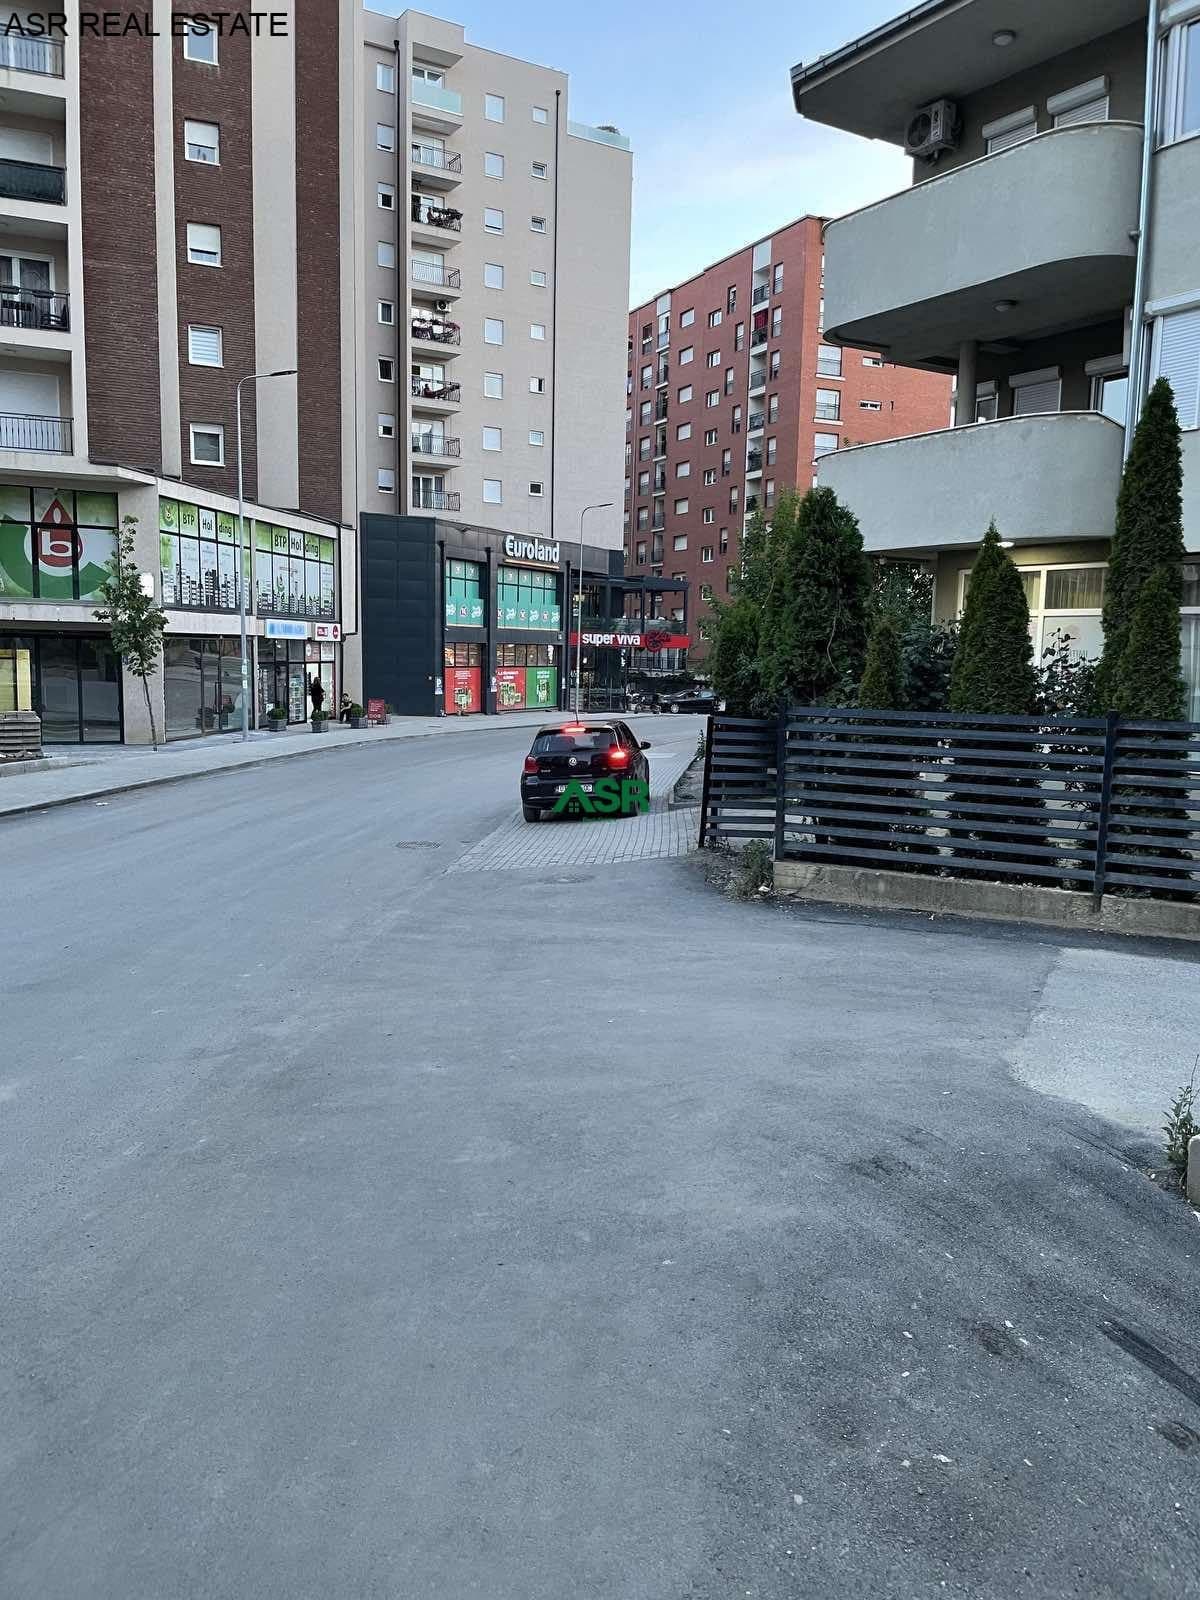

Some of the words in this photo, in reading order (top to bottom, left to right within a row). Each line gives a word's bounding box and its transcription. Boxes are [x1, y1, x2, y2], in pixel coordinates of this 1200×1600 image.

[182, 513, 195, 525] BTP
[274, 534, 287, 549] BTP
[505, 534, 560, 563] Euroland
[582, 632, 616, 646] super
[616, 633, 641, 646] viva
